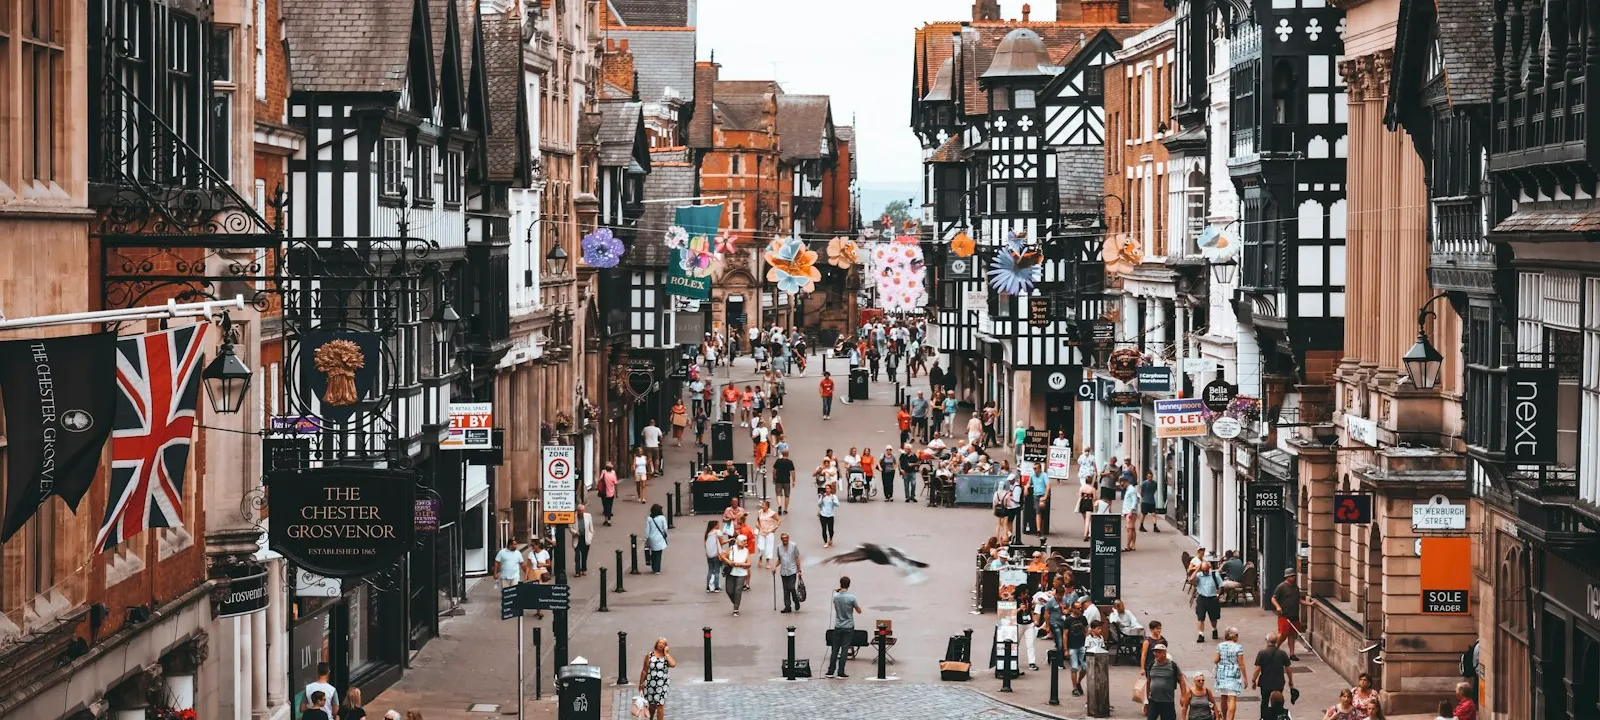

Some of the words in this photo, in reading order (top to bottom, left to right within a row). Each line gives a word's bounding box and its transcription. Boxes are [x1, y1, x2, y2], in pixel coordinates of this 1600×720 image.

[671, 277, 704, 289] ROLEX
[31, 343, 48, 362] THE
[36, 364, 56, 424] CHESTER
[1158, 403, 1201, 411] kenneymoore
[448, 416, 464, 427] ET
[470, 415, 488, 427] BY
[1159, 415, 1176, 424] TO
[1180, 414, 1203, 424] LET
[1515, 382, 1537, 455] next
[40, 428, 56, 502] GROSVEN
[323, 487, 360, 500] THE
[302, 506, 381, 520] CHESTER
[287, 525, 396, 538] GROSVENOR
[1096, 545, 1116, 553] Rows
[1429, 592, 1461, 602] SOLE
[1586, 584, 1600, 620] ne
